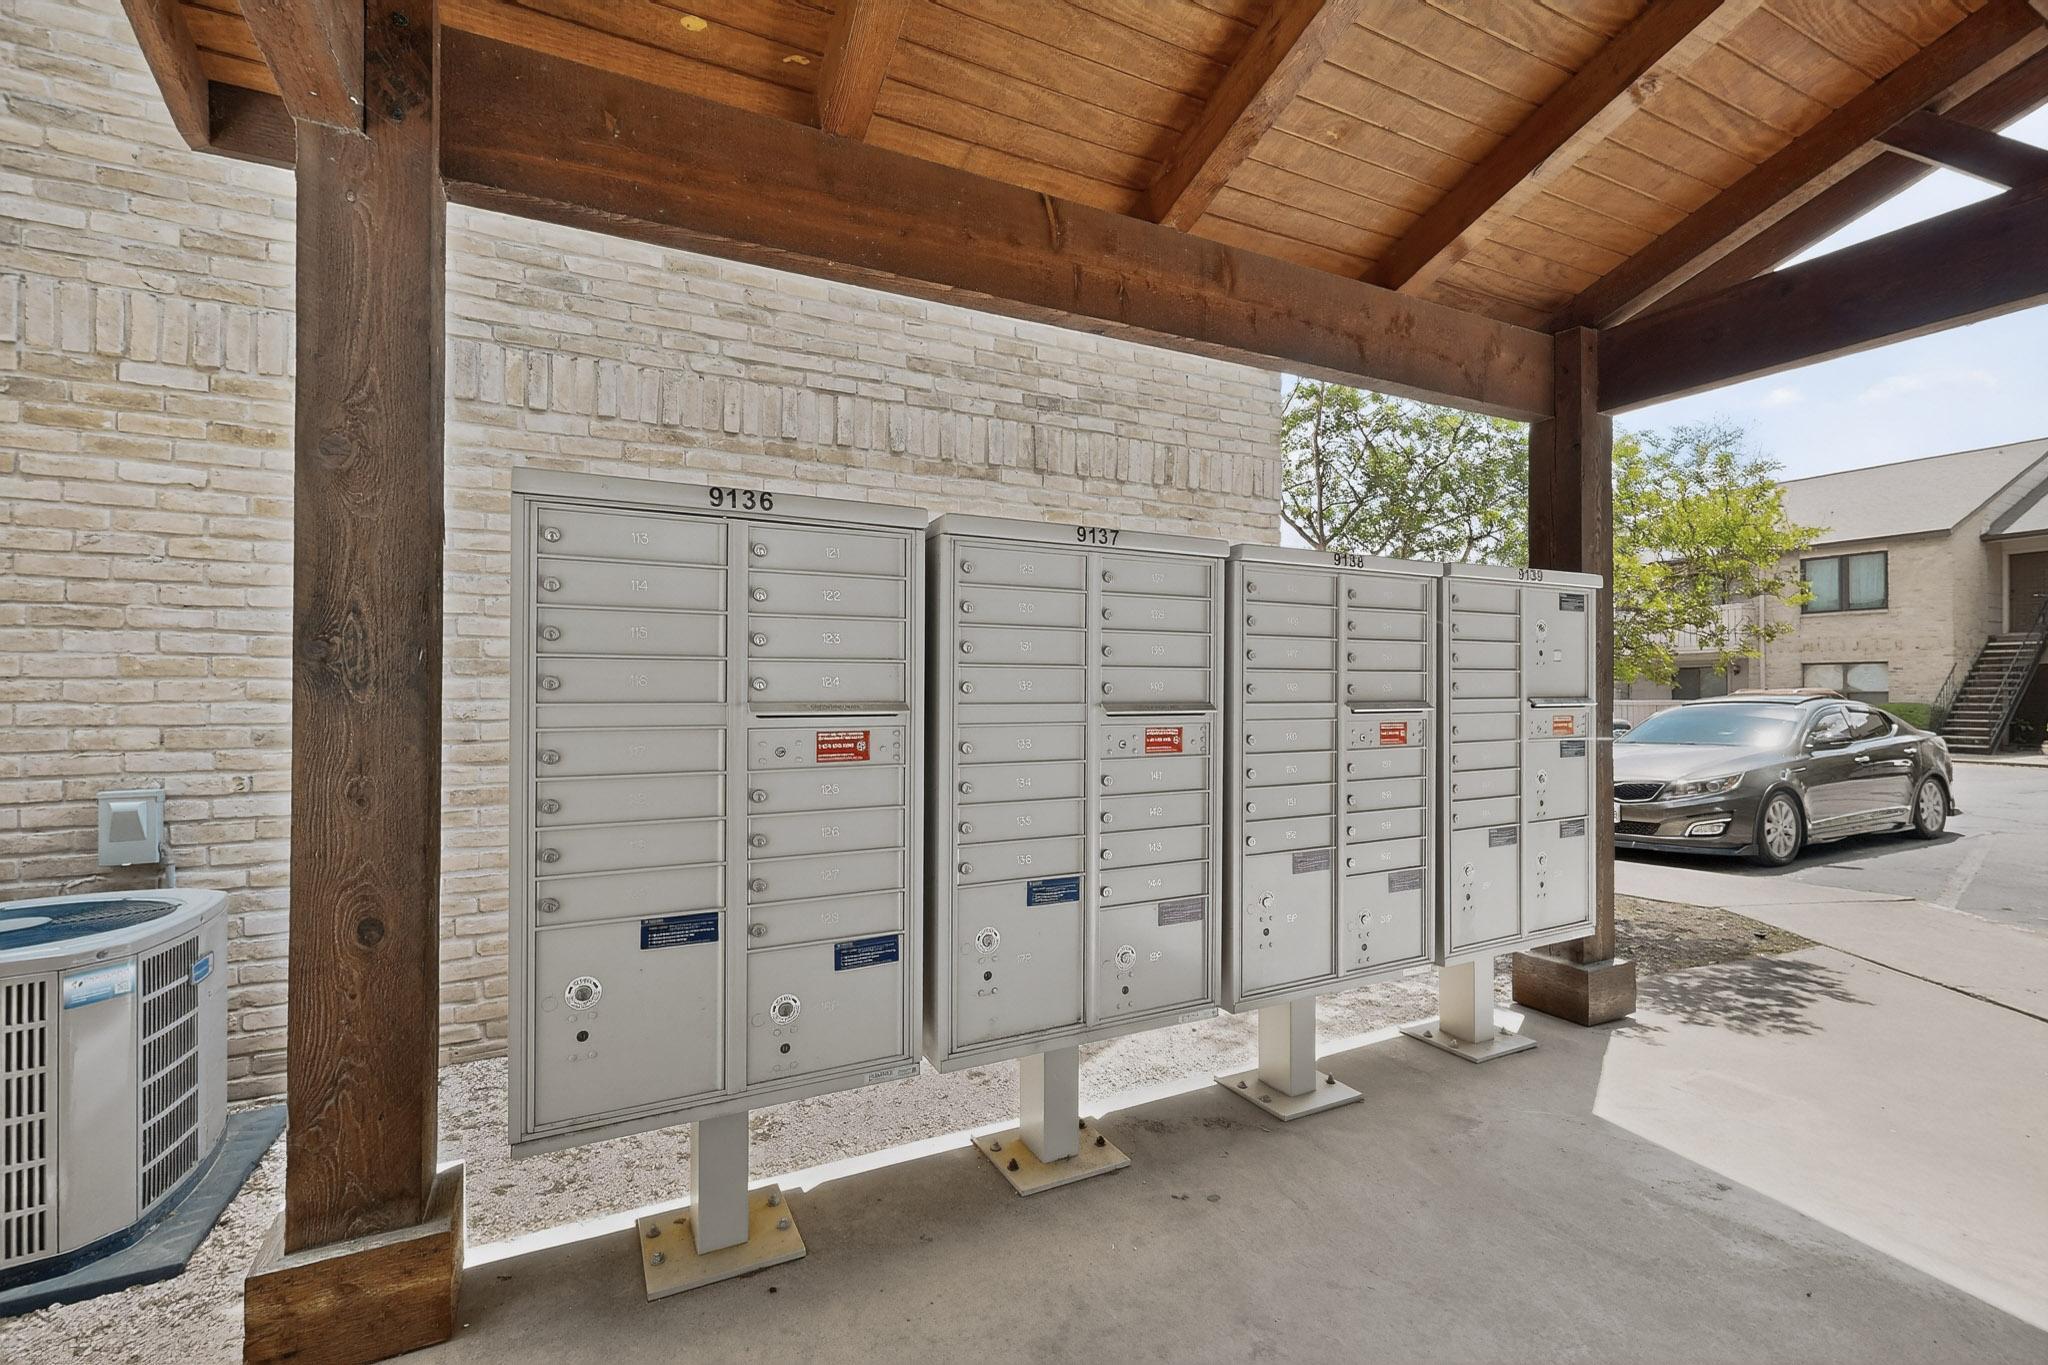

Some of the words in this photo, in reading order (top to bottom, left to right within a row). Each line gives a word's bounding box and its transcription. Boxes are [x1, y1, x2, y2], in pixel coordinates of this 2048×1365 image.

[709, 487, 774, 512] 9136
[631, 532, 650, 545] 113
[1076, 527, 1120, 546] 9137
[825, 547, 840, 559] 121
[1334, 553, 1365, 569] 9138
[1518, 568, 1544, 582] 9139
[631, 579, 648, 591] 114
[822, 590, 841, 602] 122
[630, 626, 648, 639] 115
[821, 633, 841, 645] 123
[821, 676, 840, 688] 124
[821, 783, 840, 795] 125
[821, 826, 841, 838] 126
[820, 868, 840, 881] 127
